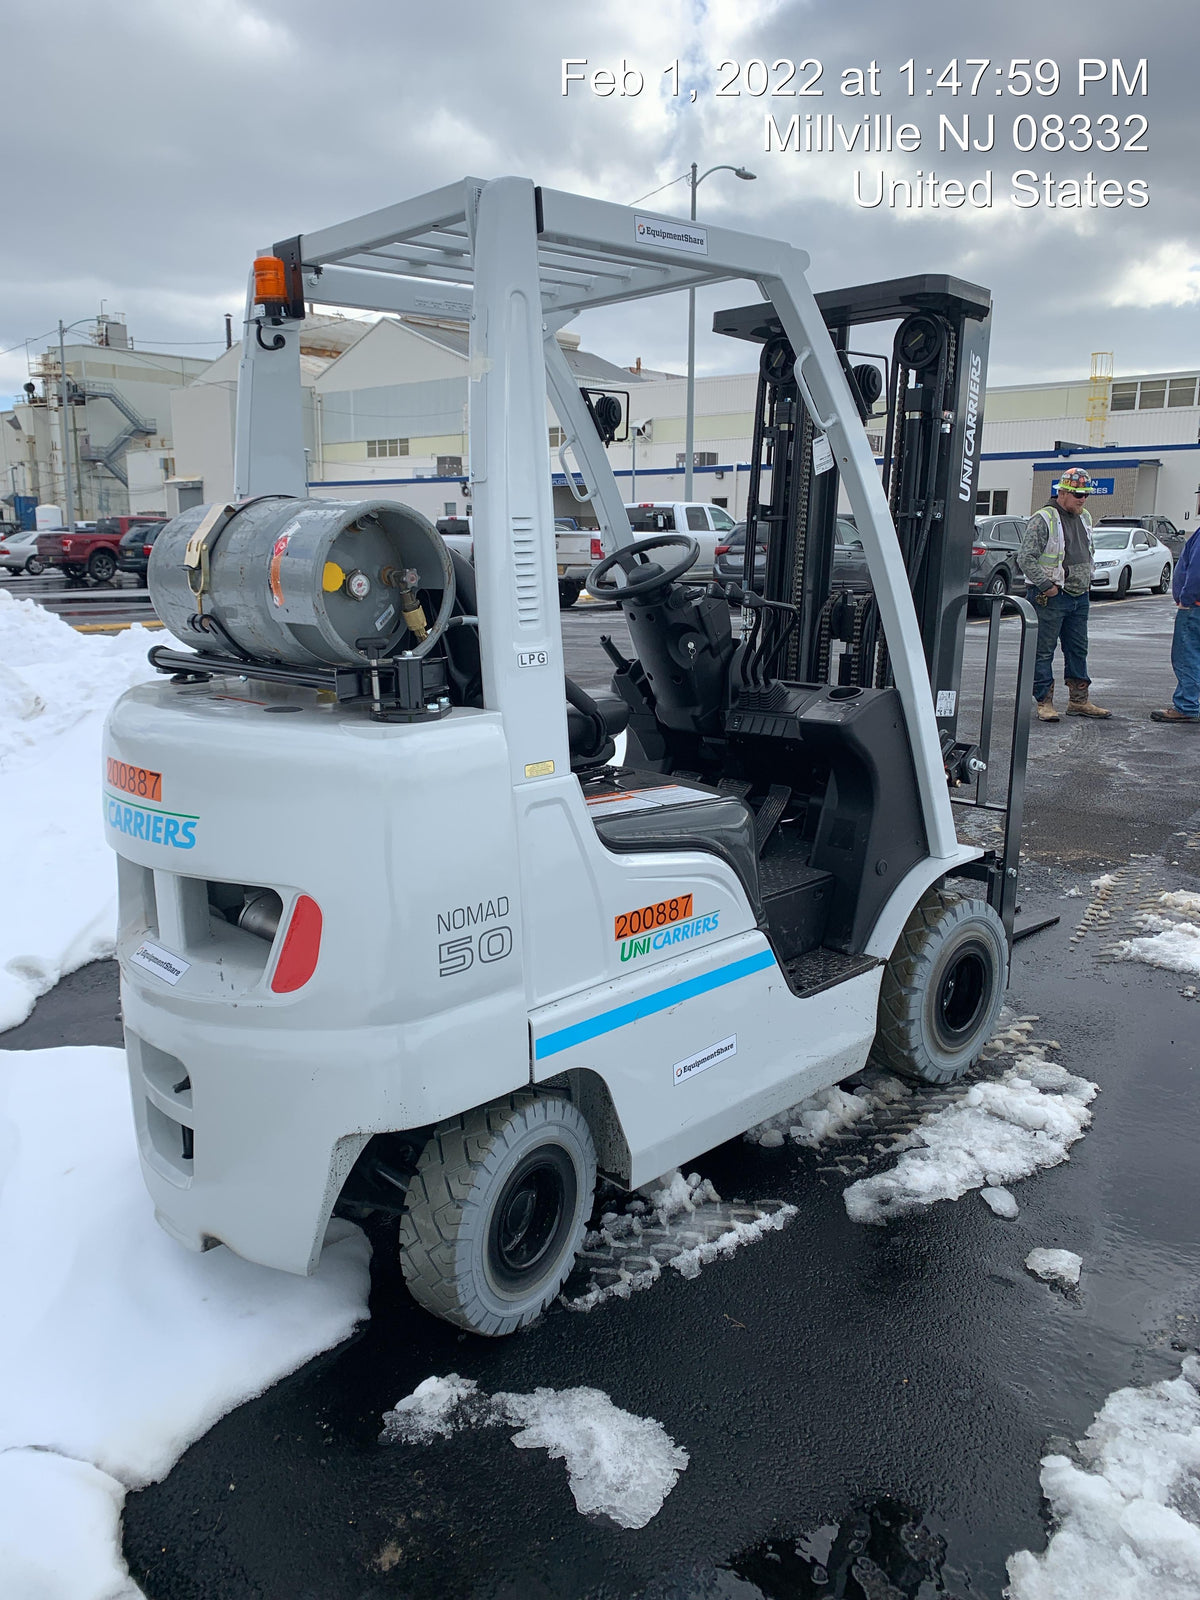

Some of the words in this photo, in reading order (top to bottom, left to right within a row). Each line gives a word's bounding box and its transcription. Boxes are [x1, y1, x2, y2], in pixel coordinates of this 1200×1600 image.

[646, 226, 704, 245] EquipmentShare
[958, 353, 982, 501] UNICARRIERS
[520, 653, 546, 665] LPG
[107, 757, 161, 799] 200887
[437, 896, 510, 934] NOMAD
[615, 894, 693, 939] 200887
[438, 925, 513, 978] 50
[619, 913, 719, 962] UNICARRIERS
[141, 949, 181, 977] EquipmentShare
[682, 1043, 734, 1074] EquipmentShare
